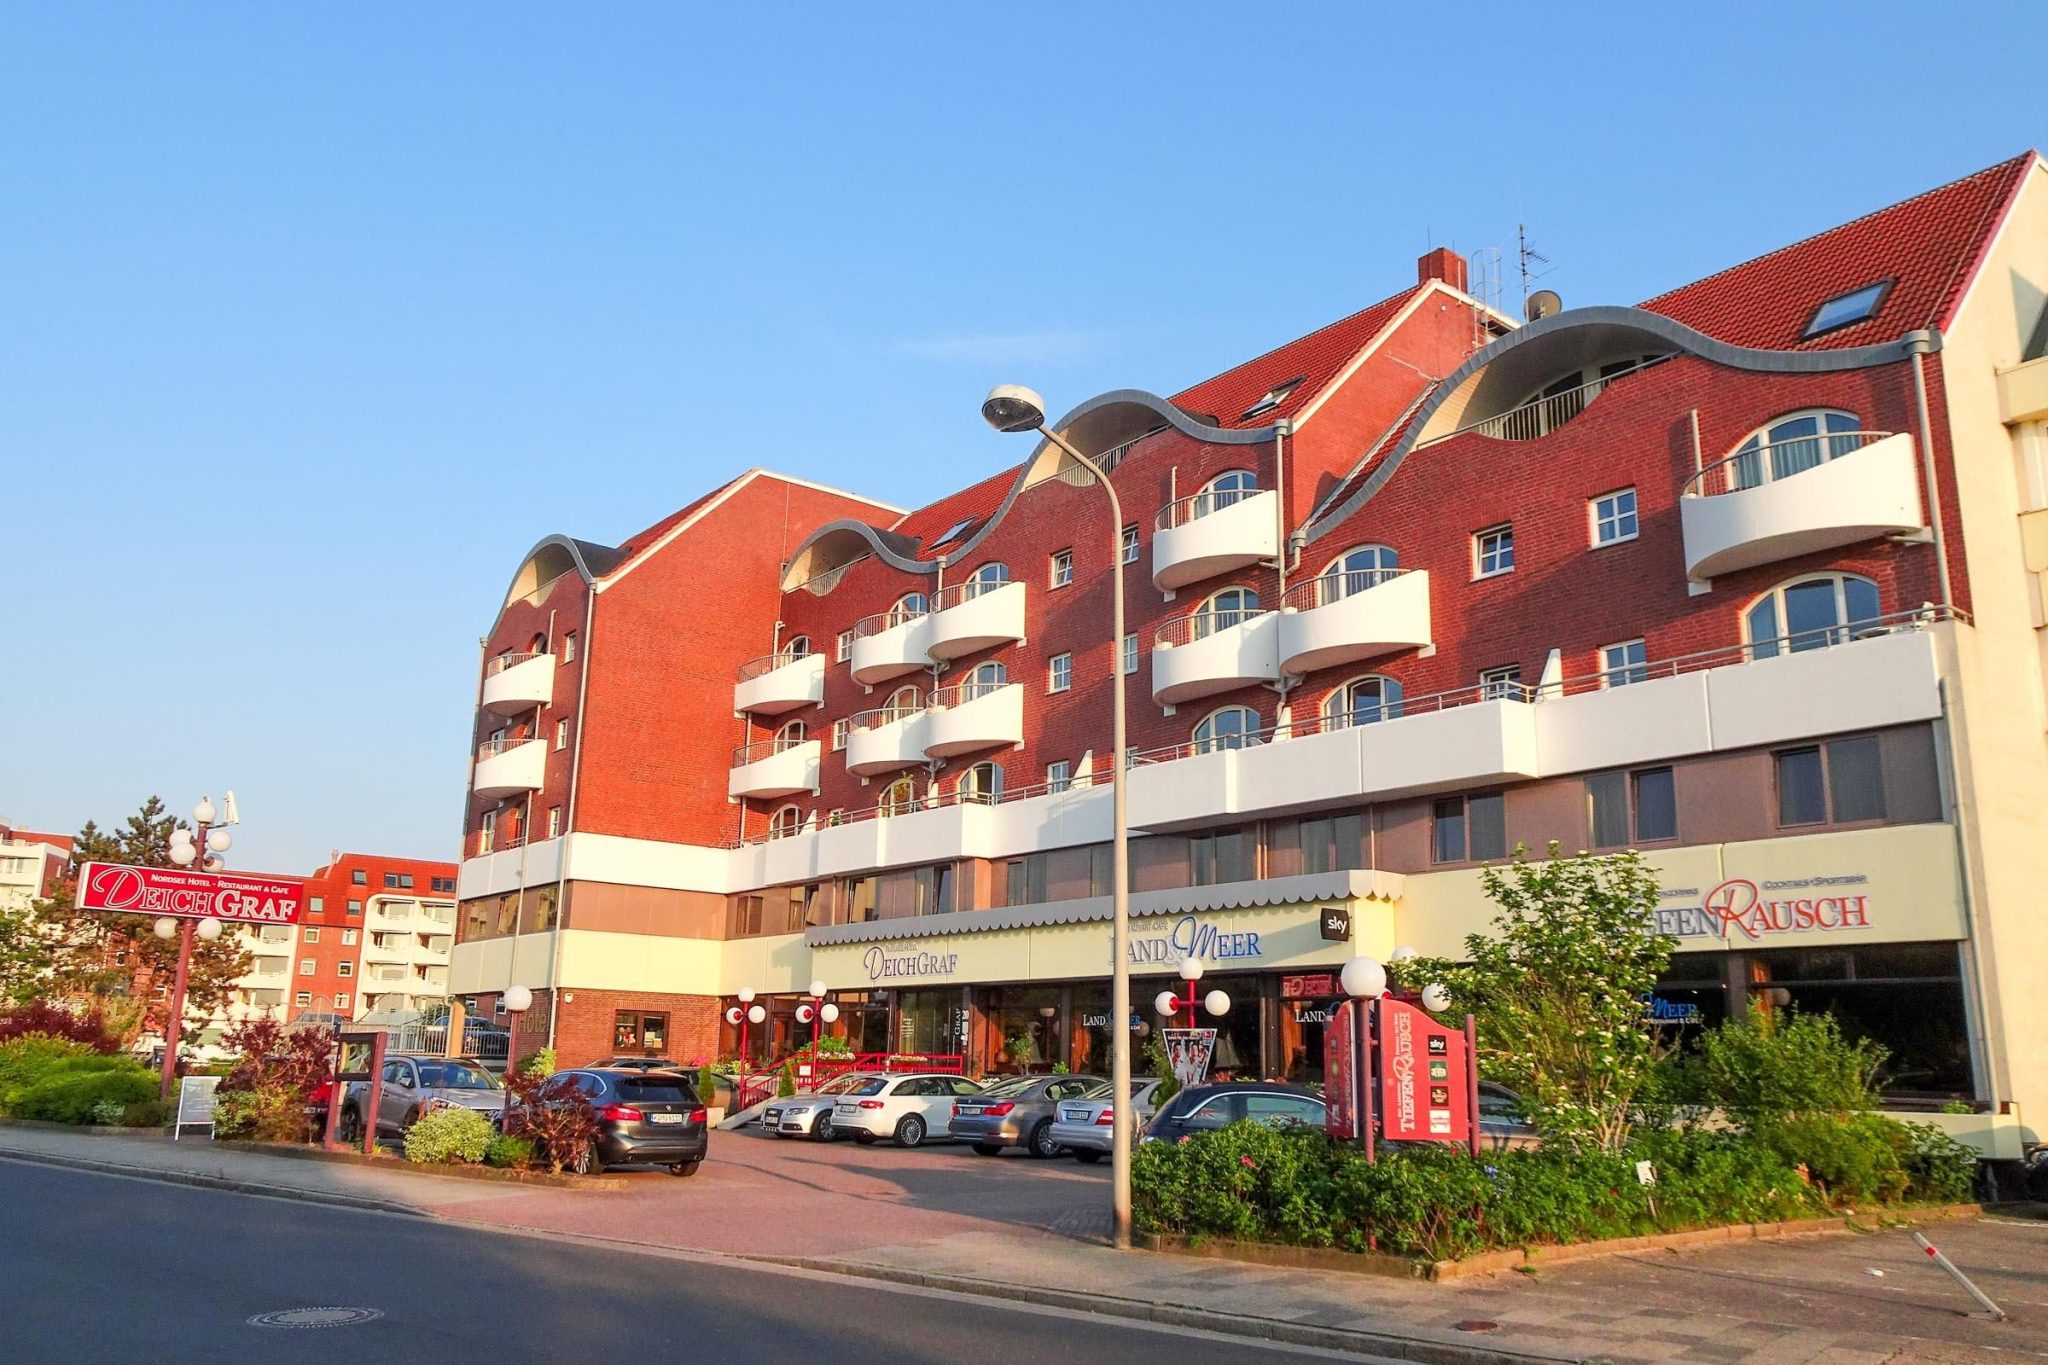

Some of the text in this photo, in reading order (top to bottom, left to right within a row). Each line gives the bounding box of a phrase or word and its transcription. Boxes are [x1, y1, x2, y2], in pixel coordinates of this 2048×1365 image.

[151, 873, 187, 885] NORDSEE
[188, 877, 211, 887] HOTEL
[217, 880, 263, 892] RESTAURANT
[1327, 915, 1348, 934] sky
[1083, 1014, 1106, 1026] LAND
[1294, 1008, 1326, 1023] LAND
[1430, 1039, 1445, 1049] sky
